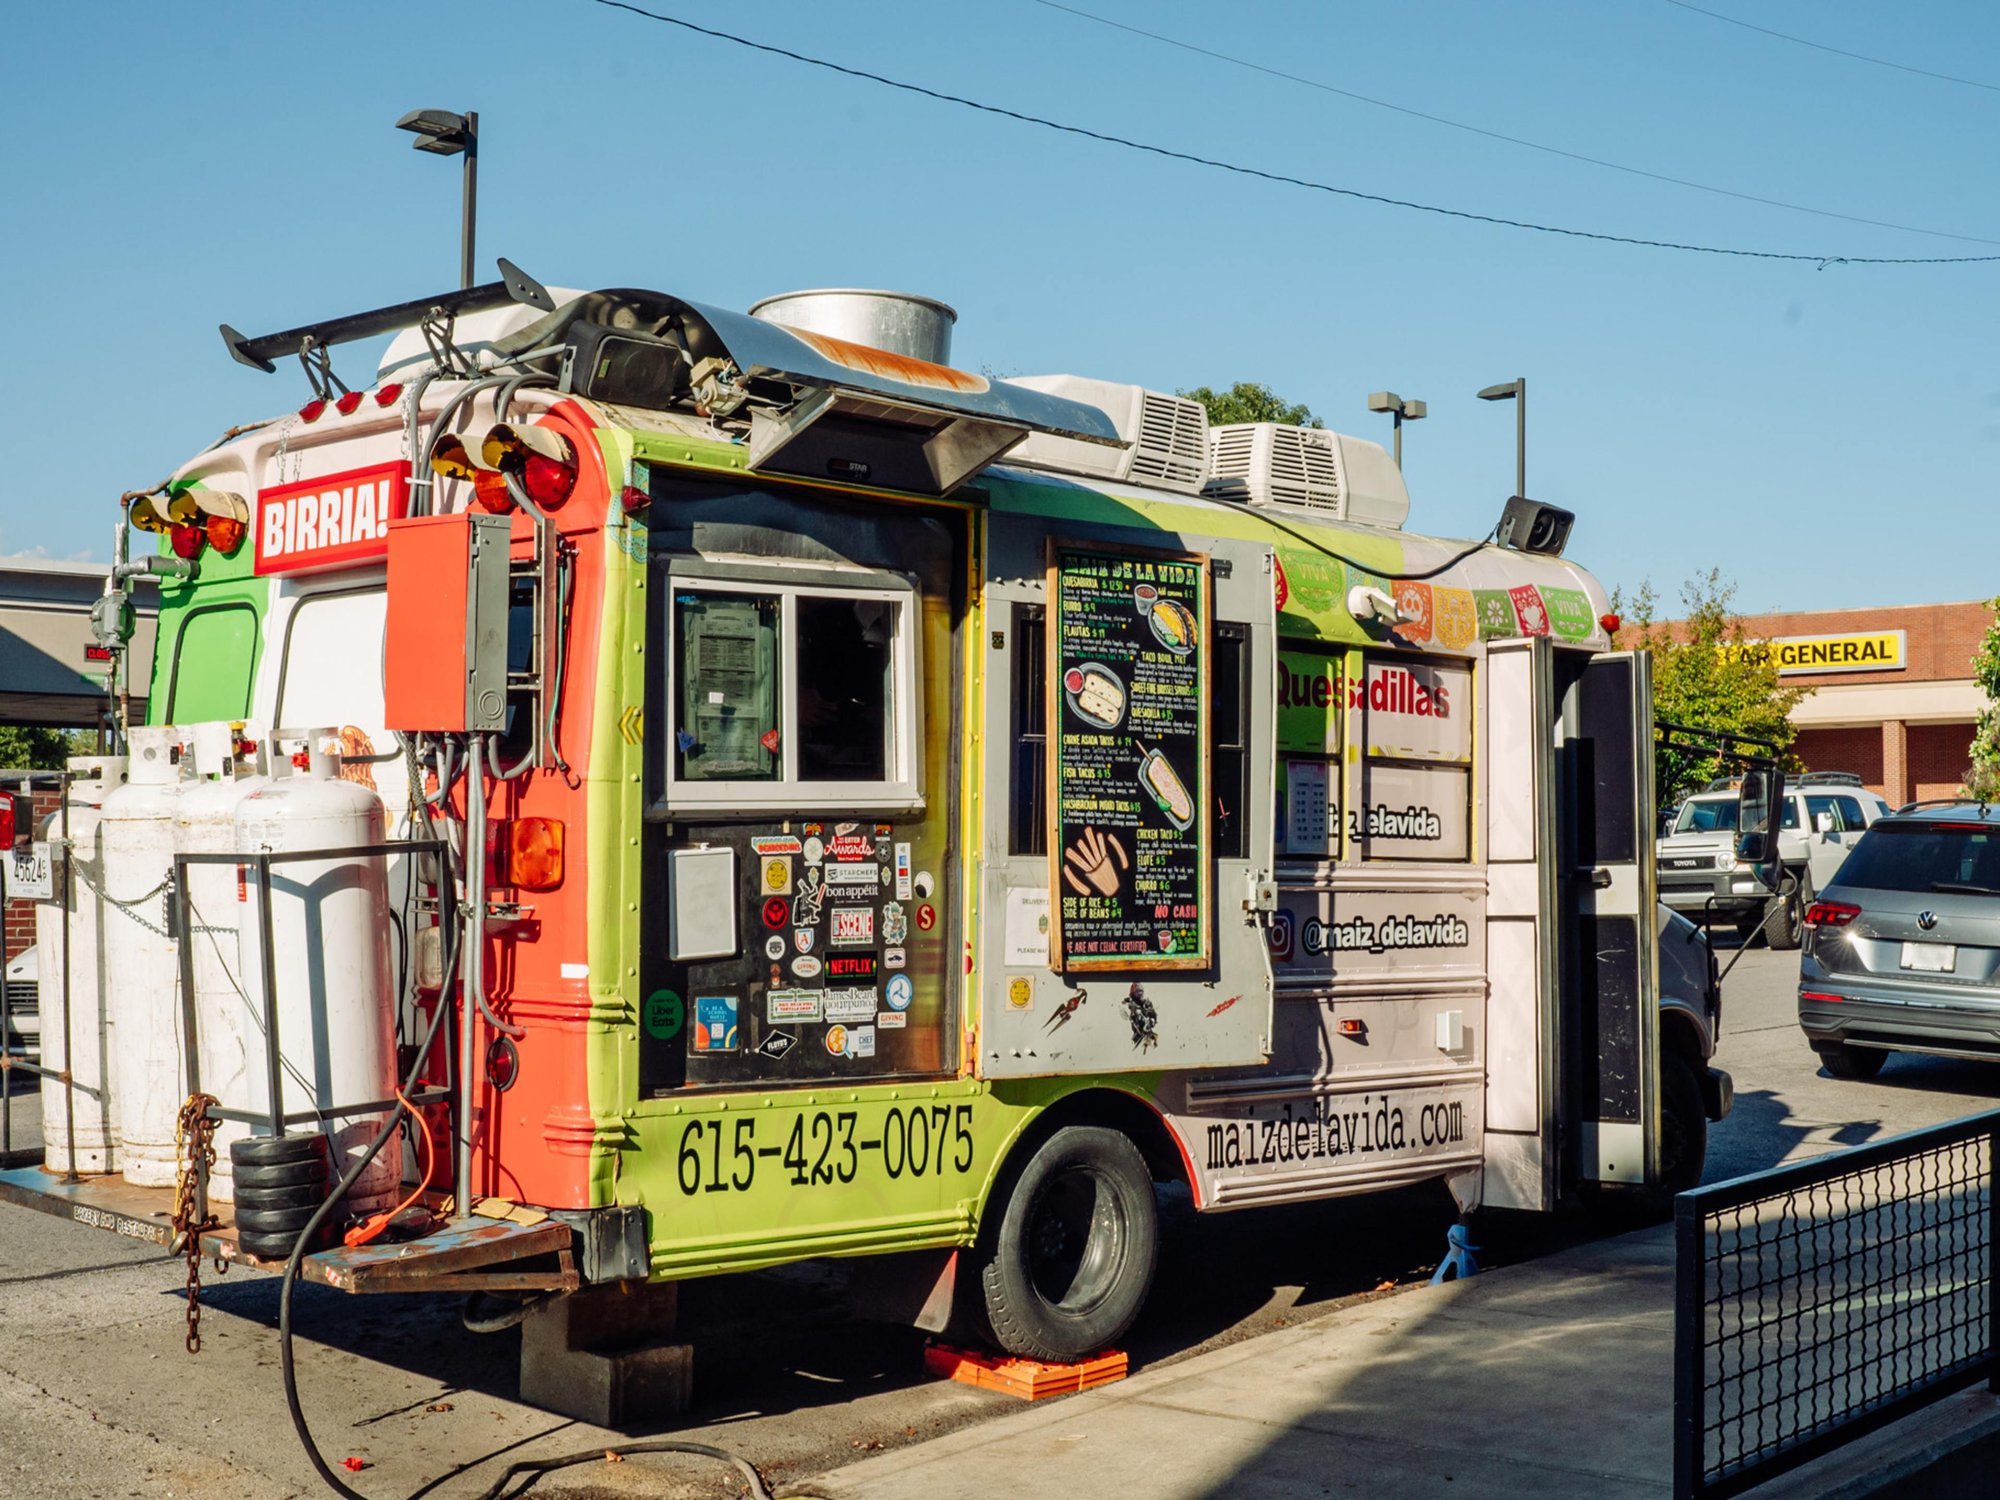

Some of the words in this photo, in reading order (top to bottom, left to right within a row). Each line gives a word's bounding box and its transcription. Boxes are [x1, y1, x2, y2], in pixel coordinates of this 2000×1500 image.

[262, 479, 390, 559] BIRRIA!
[1112, 561, 1133, 579] DE
[1135, 563, 1155, 581] LA
[1158, 565, 1196, 586] VIDA
[1299, 563, 1328, 582] VIVA
[1558, 600, 1583, 618] VIVA
[1063, 625, 1091, 638] FLAUTAS
[1141, 651, 1156, 663] TACO
[1780, 640, 1893, 665] GENERAL
[1275, 659, 1450, 718] Quesadillas
[1081, 734, 1099, 746] ASADA
[1099, 735, 1115, 747] TACOS
[1063, 767, 1077, 778] FISH
[1077, 767, 1096, 779] TACOS
[1136, 828, 1158, 840] CHICKEN
[1159, 828, 1173, 840] TACO
[824, 835, 875, 855] Awards
[1137, 854, 1154, 867] ELOTE
[1673, 859, 1697, 867] TOYOTA
[839, 868, 878, 877] STARCHEFS
[826, 885, 846, 898] bon
[846, 884, 879, 899] appétit
[1063, 897, 1077, 908] SIDE
[1080, 897, 1087, 907] OF
[1088, 897, 1102, 908] RICE
[920, 906, 931, 929] S
[1063, 908, 1077, 919] SIDE
[1080, 908, 1087, 918] OF
[1088, 908, 1110, 919] BEANS
[1154, 904, 1169, 918] NO
[1173, 904, 1197, 918] CASH
[840, 913, 873, 937] SCENE
[1302, 914, 1469, 956] @maiz_delavida
[1074, 941, 1087, 954] ARE
[1087, 940, 1099, 953] NOT
[1100, 941, 1118, 953] CELIAC
[1120, 940, 1147, 953] CERTIFIED
[830, 958, 872, 975] NETFLIX
[824, 988, 850, 1001] James
[850, 987, 877, 1000] Beard
[652, 1005, 674, 1015] Uber
[652, 1016, 674, 1027] Eats
[880, 1014, 903, 1023] GIVING
[858, 1035, 873, 1045] CHEF
[1207, 1095, 1464, 1169] maizdelavida.com
[677, 1104, 974, 1196] 615-423-0075
